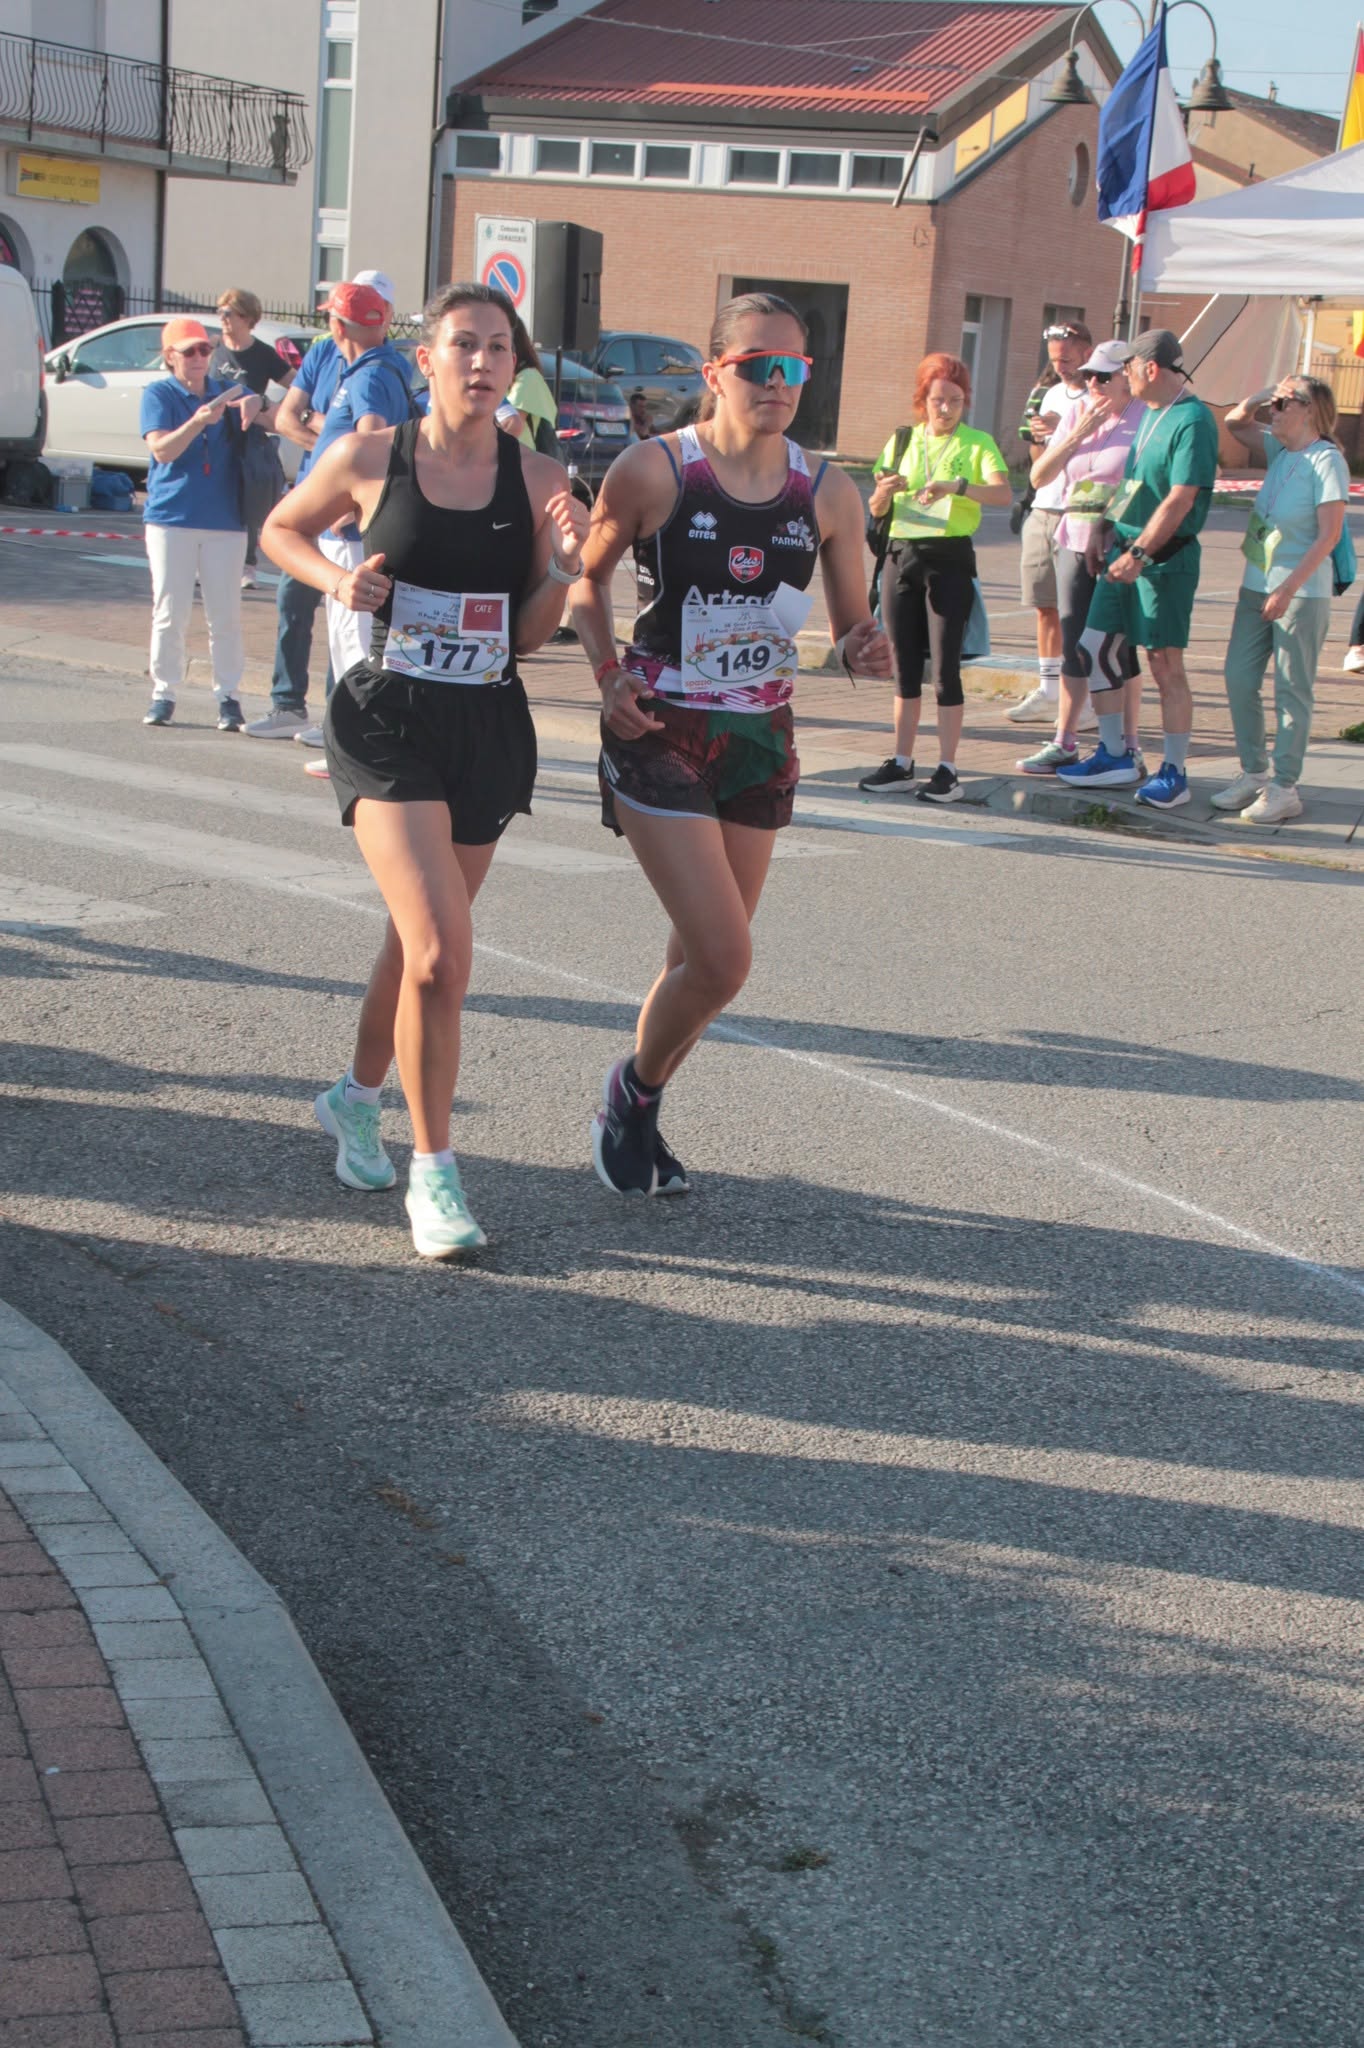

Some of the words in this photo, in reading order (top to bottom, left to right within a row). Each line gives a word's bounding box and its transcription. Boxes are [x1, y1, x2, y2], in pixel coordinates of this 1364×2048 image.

[771, 535, 804, 548] PARMA
[731, 552, 761, 569] Cus
[421, 639, 480, 671] 177
[716, 645, 770, 677] 149
[684, 679, 713, 689] spazio
